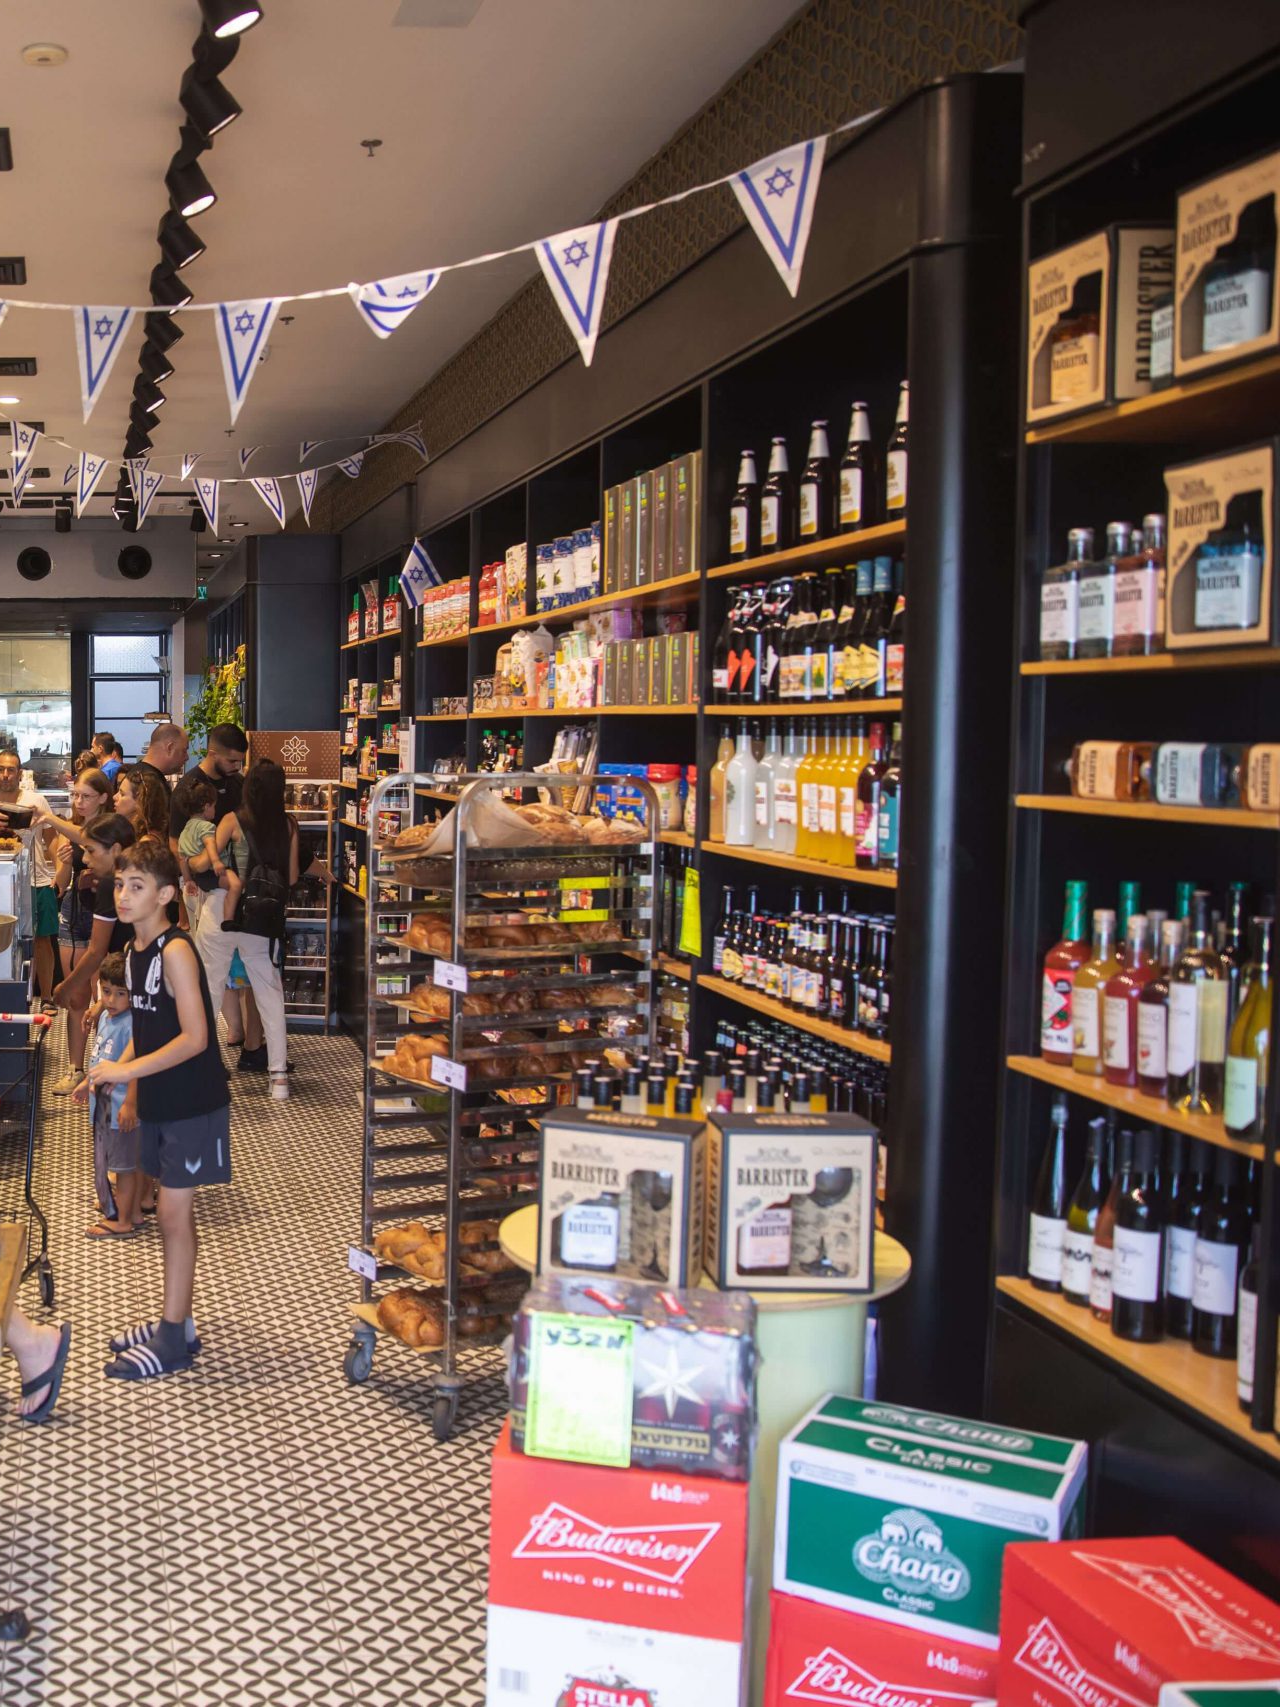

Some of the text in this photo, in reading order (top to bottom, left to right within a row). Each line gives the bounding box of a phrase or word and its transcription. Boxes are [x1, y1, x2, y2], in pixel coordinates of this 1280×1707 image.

[551, 1160, 620, 1188] BARRISTER
[736, 1166, 810, 1187] BARRISTER
[567, 1221, 613, 1236] BARRISTER
[916, 1416, 1025, 1449] Chang
[866, 1437, 992, 1474] CLASSIC
[531, 1513, 698, 1562] Budweiser
[857, 1540, 963, 1591] Chang
[542, 1569, 586, 1586] KING
[591, 1577, 616, 1589] OF
[882, 1587, 935, 1612] CLASSIC
[574, 1686, 645, 1707] STELLA
